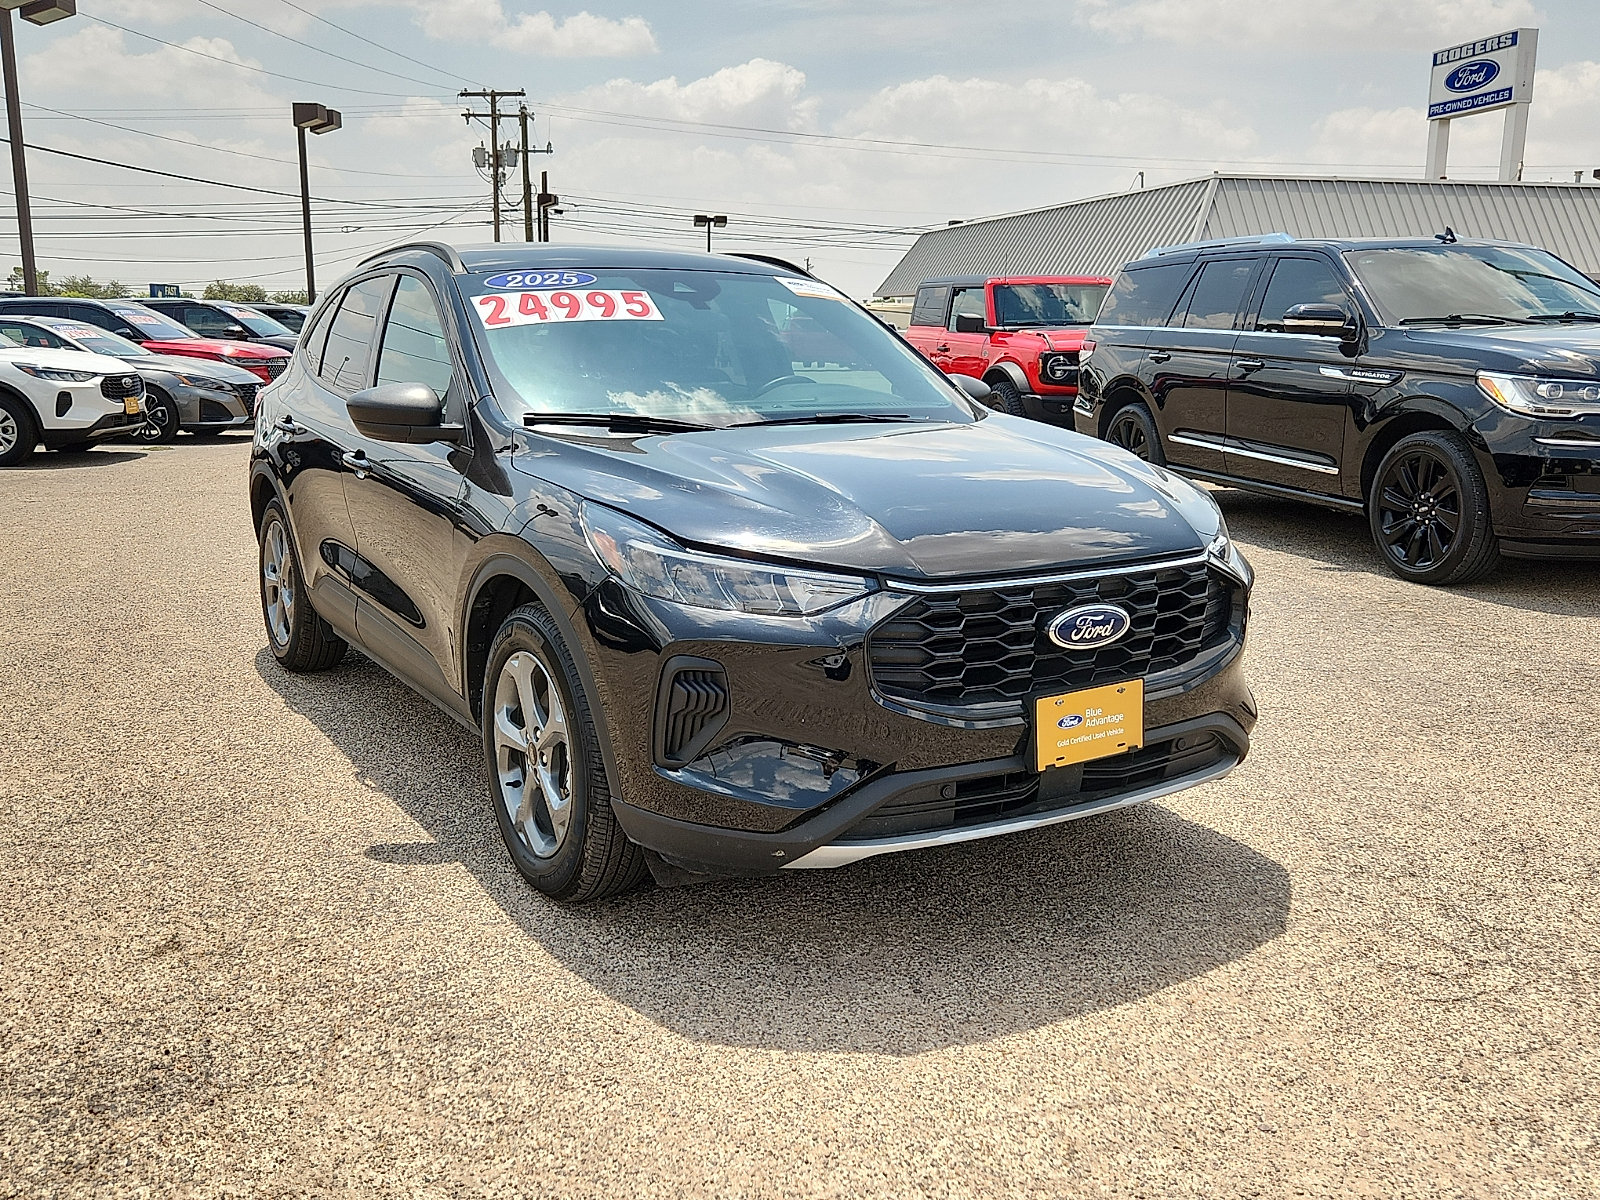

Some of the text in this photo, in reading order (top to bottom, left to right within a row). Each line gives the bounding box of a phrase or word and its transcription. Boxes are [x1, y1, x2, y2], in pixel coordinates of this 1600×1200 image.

[1436, 33, 1512, 65] ROGERS
[1454, 64, 1488, 88] Ford
[1430, 90, 1510, 115] PRE-OWNED VEHICLES
[505, 271, 580, 288] 2025
[164, 285, 177, 296] FAST
[479, 291, 653, 326] 24995
[1351, 370, 1391, 379] NAVIGATOR
[1071, 614, 1115, 641] Ford
[1061, 715, 1080, 728] Ford
[1085, 708, 1103, 718] Blue
[1085, 713, 1124, 728] Advantage
[1056, 728, 1125, 748] Gold Certified Used Vehicle
